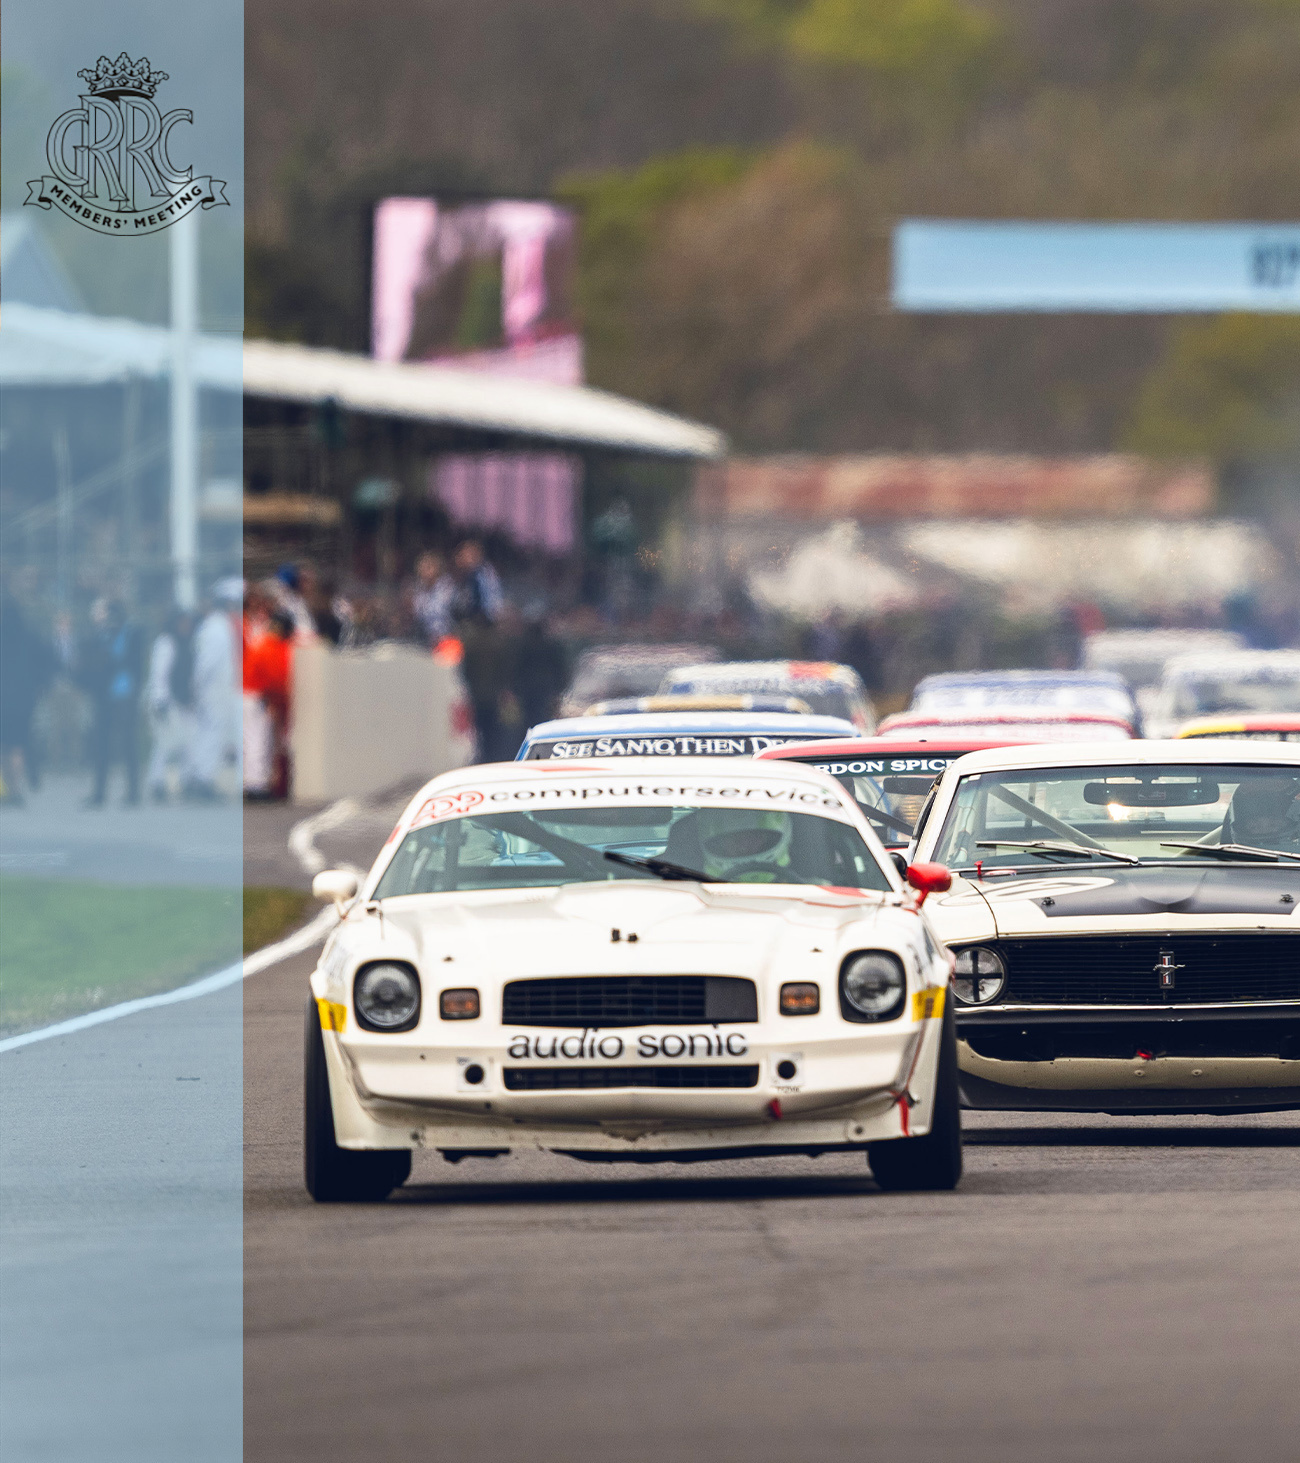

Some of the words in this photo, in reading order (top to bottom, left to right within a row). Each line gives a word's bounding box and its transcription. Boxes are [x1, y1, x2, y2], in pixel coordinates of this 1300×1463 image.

[549, 742, 594, 760] SEE
[814, 760, 885, 775] RDON
[490, 786, 844, 809] computerservice
[508, 1027, 625, 1059] audio
[636, 1024, 748, 1059] sonic
